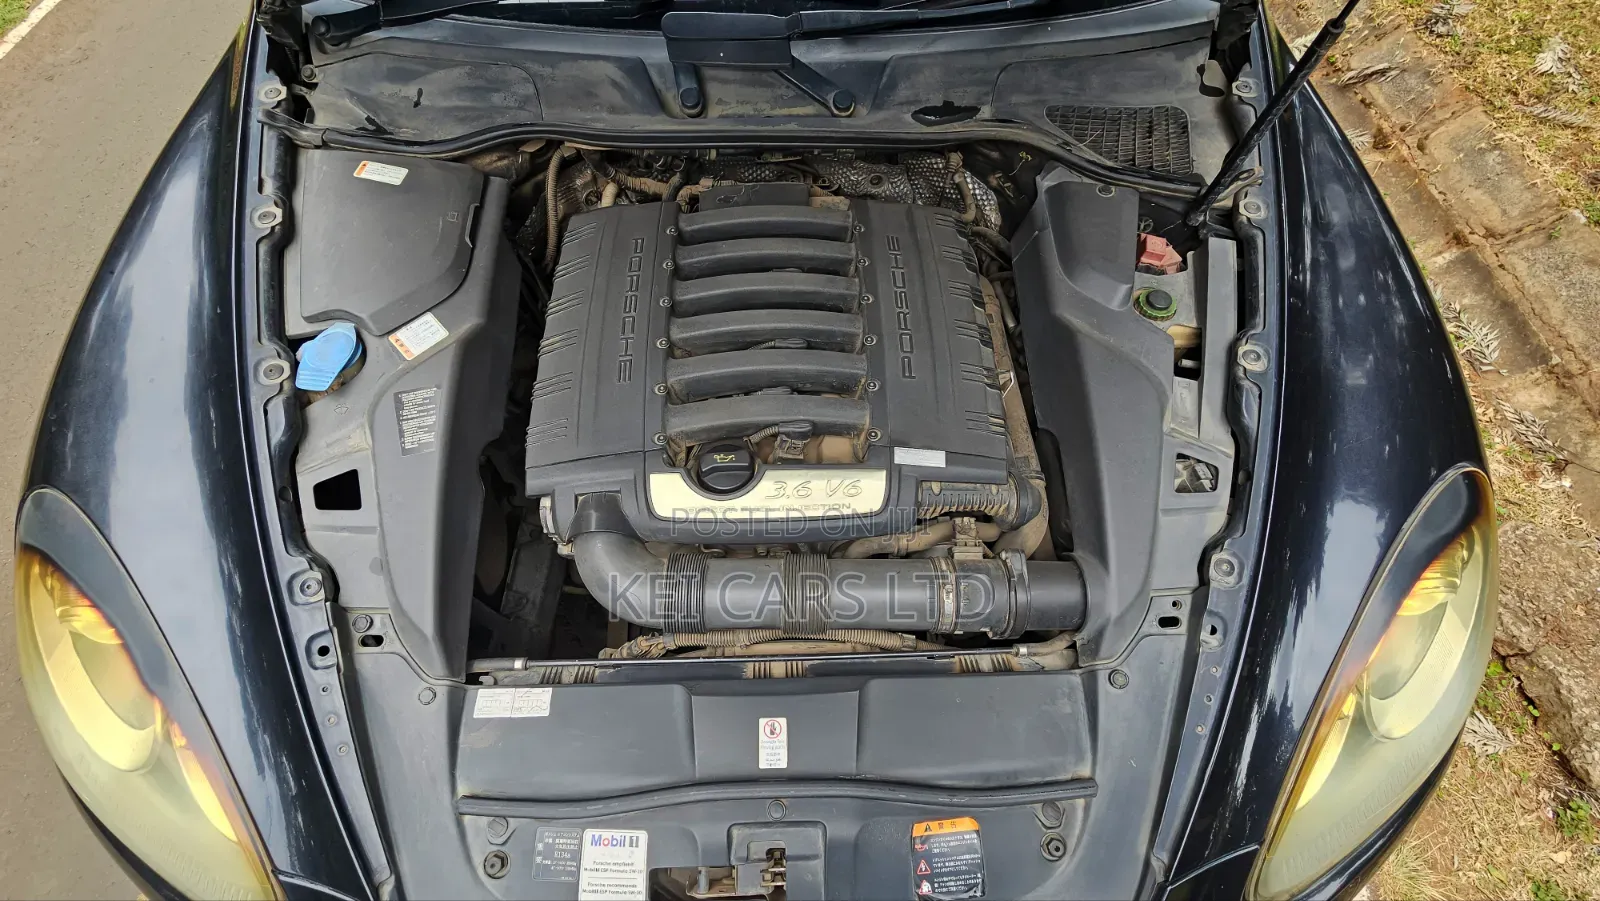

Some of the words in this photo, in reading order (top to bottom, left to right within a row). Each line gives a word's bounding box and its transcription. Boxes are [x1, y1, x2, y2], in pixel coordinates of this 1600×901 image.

[617, 237, 645, 383] PORSCHE
[886, 234, 916, 380] PORSCHE
[765, 480, 813, 499] 3.6
[826, 479, 863, 498] V6
[591, 834, 626, 848] Mobil
[629, 836, 640, 848] 1
